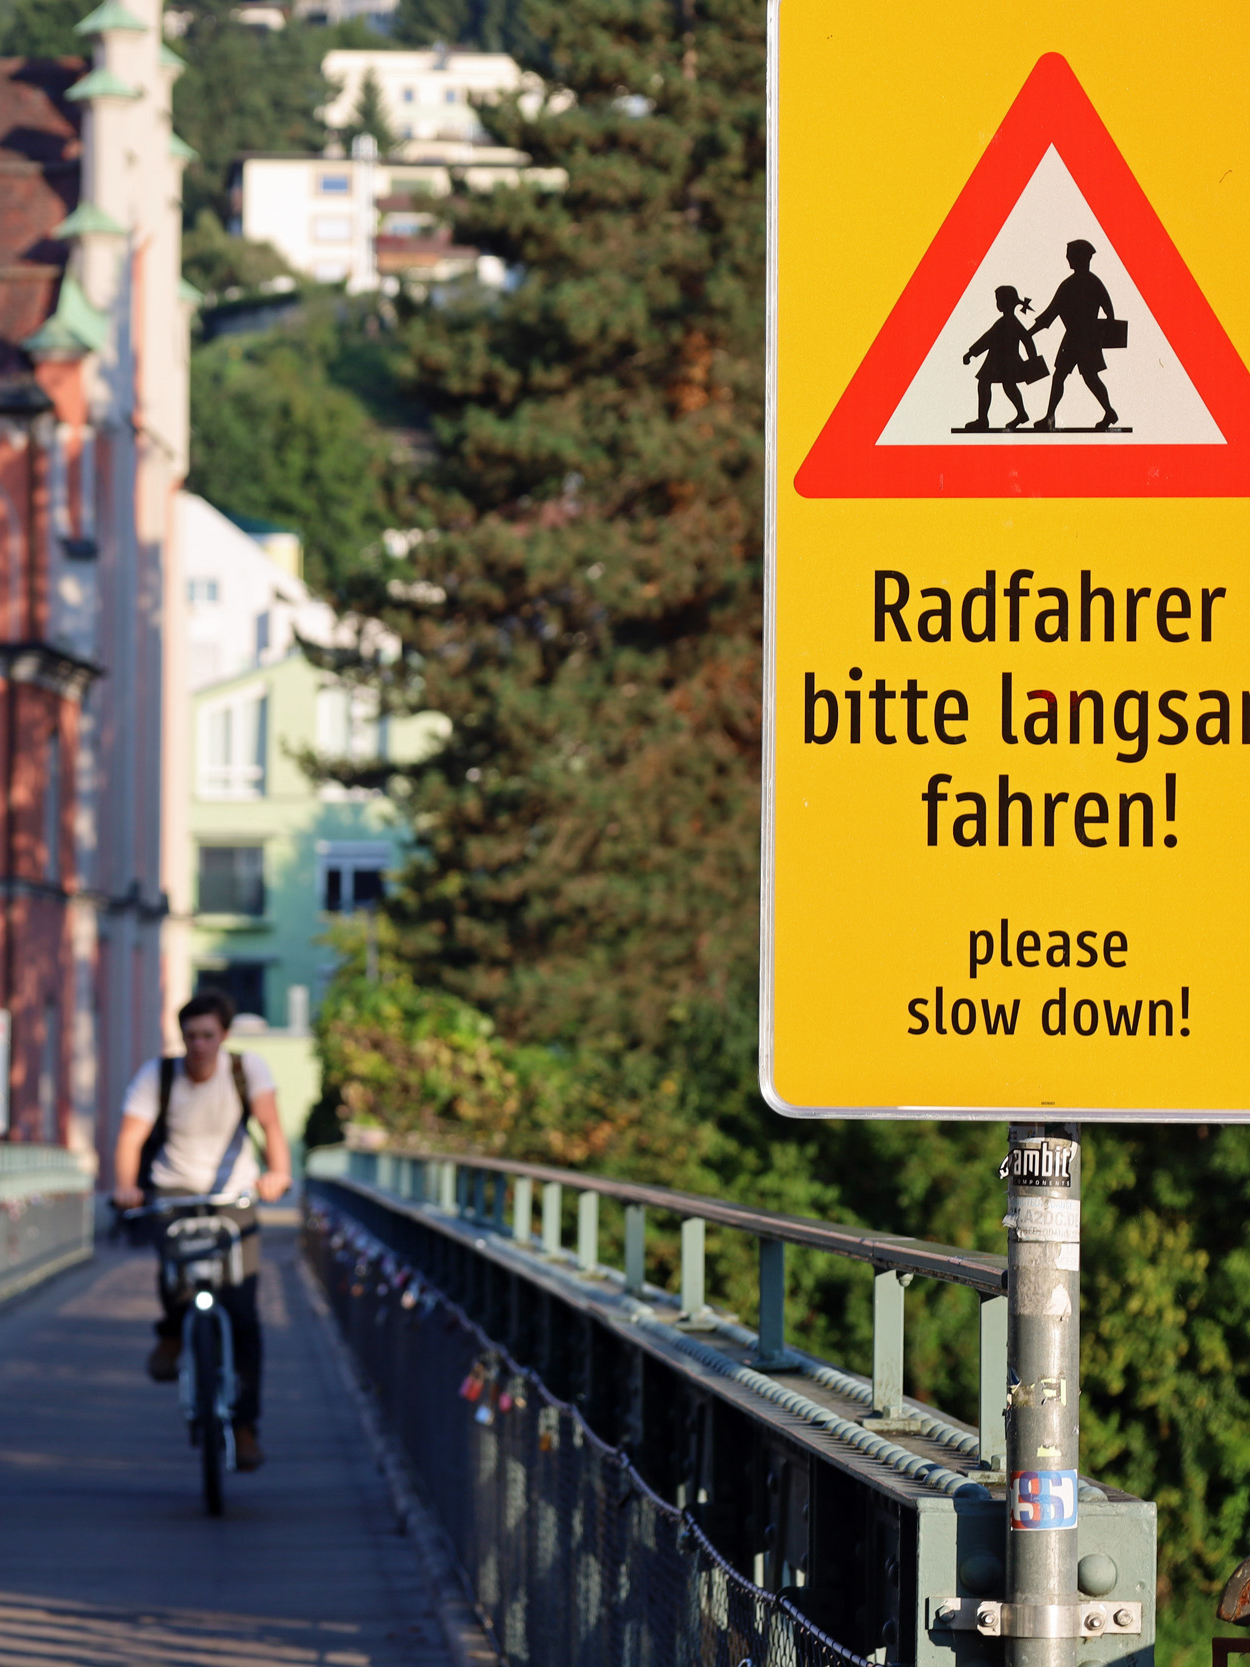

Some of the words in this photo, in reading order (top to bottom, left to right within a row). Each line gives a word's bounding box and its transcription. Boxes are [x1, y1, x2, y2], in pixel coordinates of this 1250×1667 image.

[873, 569, 1227, 643] Radfahrer
[804, 666, 970, 746] bitte
[1001, 672, 1250, 764] langsa
[921, 772, 1179, 849] fahren!
[969, 918, 1129, 979] please
[907, 986, 1021, 1036] slow
[1041, 986, 1191, 1037] down!
[1012, 1142, 1071, 1178] ambit
